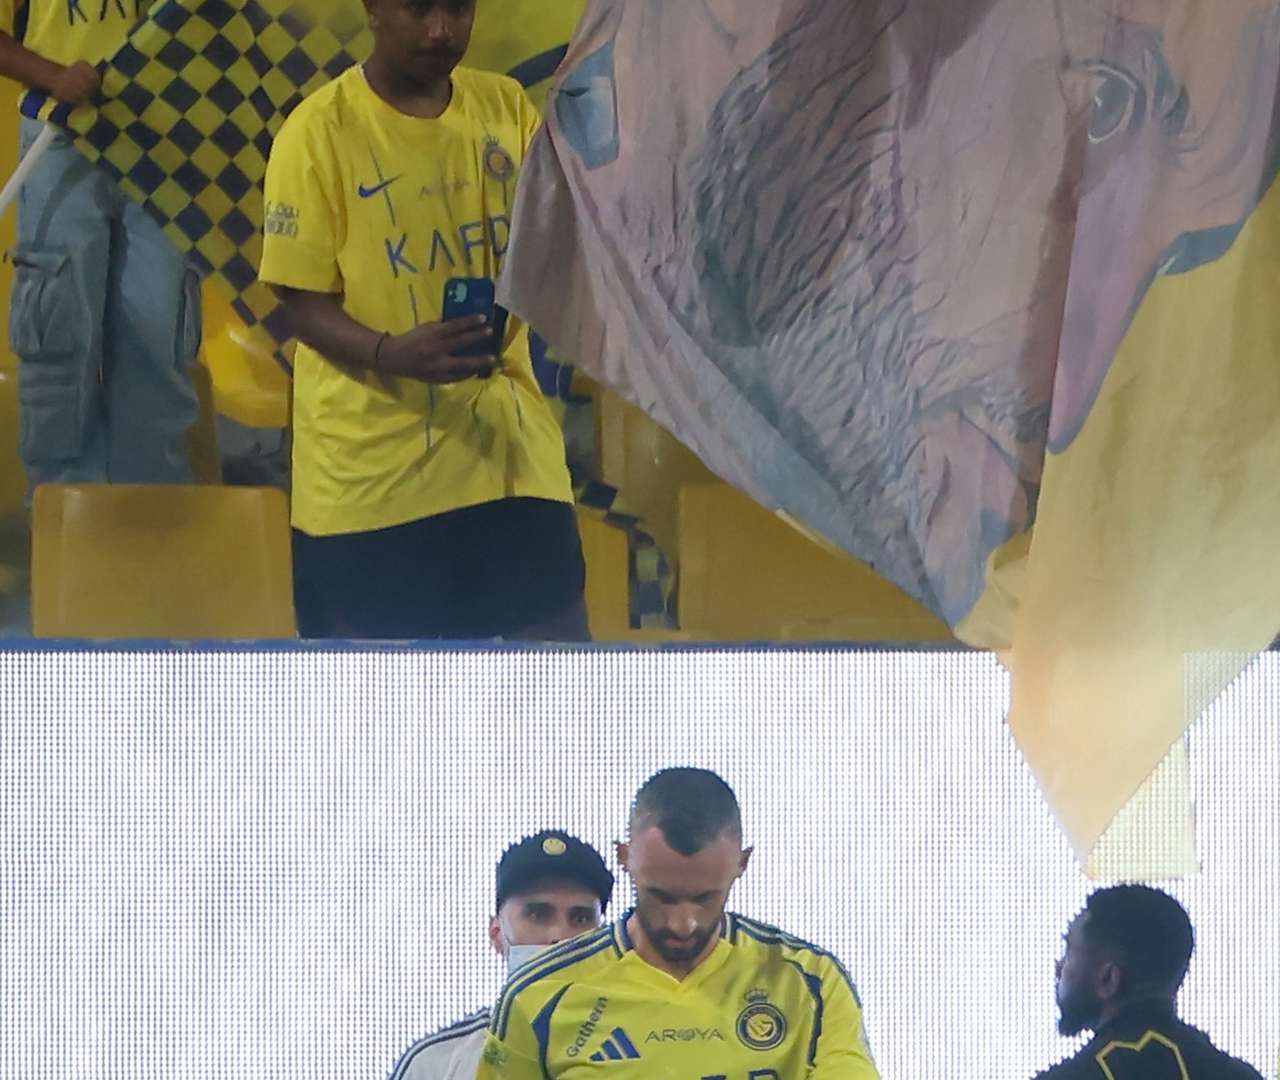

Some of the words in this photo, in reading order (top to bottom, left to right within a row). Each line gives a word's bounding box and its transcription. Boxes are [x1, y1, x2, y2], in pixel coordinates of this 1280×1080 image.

[384, 213, 512, 278] KAFD
[566, 996, 609, 1058] Gathern
[643, 1027, 725, 1043] AROYA
